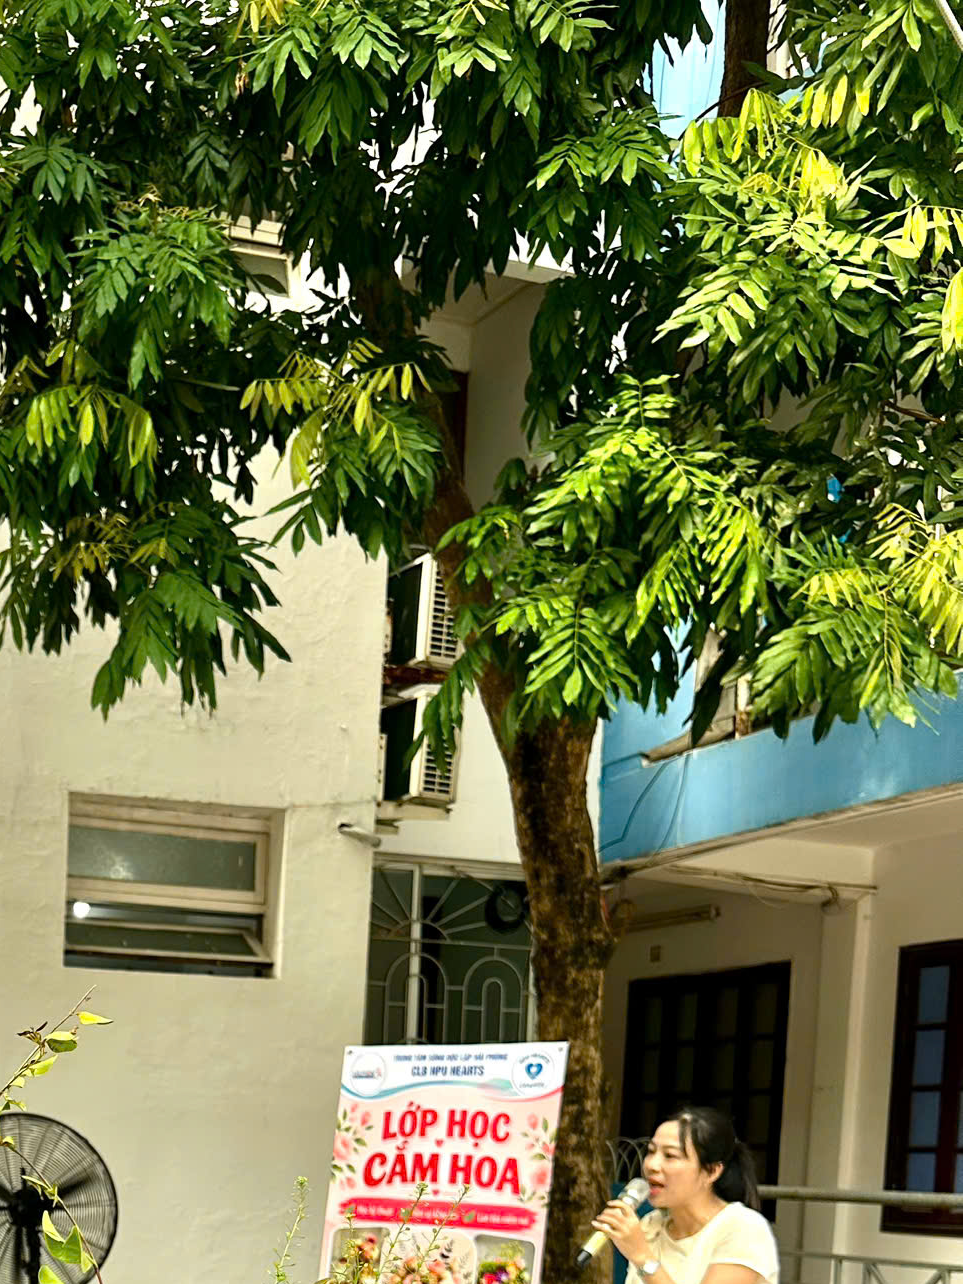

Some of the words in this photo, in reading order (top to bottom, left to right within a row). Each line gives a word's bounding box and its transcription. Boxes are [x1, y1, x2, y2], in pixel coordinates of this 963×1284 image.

[450, 1065, 485, 1077] HEARTS
[382, 1101, 438, 1140] LỚP
[446, 1108, 511, 1148] HỌC
[363, 1140, 440, 1187] CẮM
[448, 1153, 521, 1196] HOA
